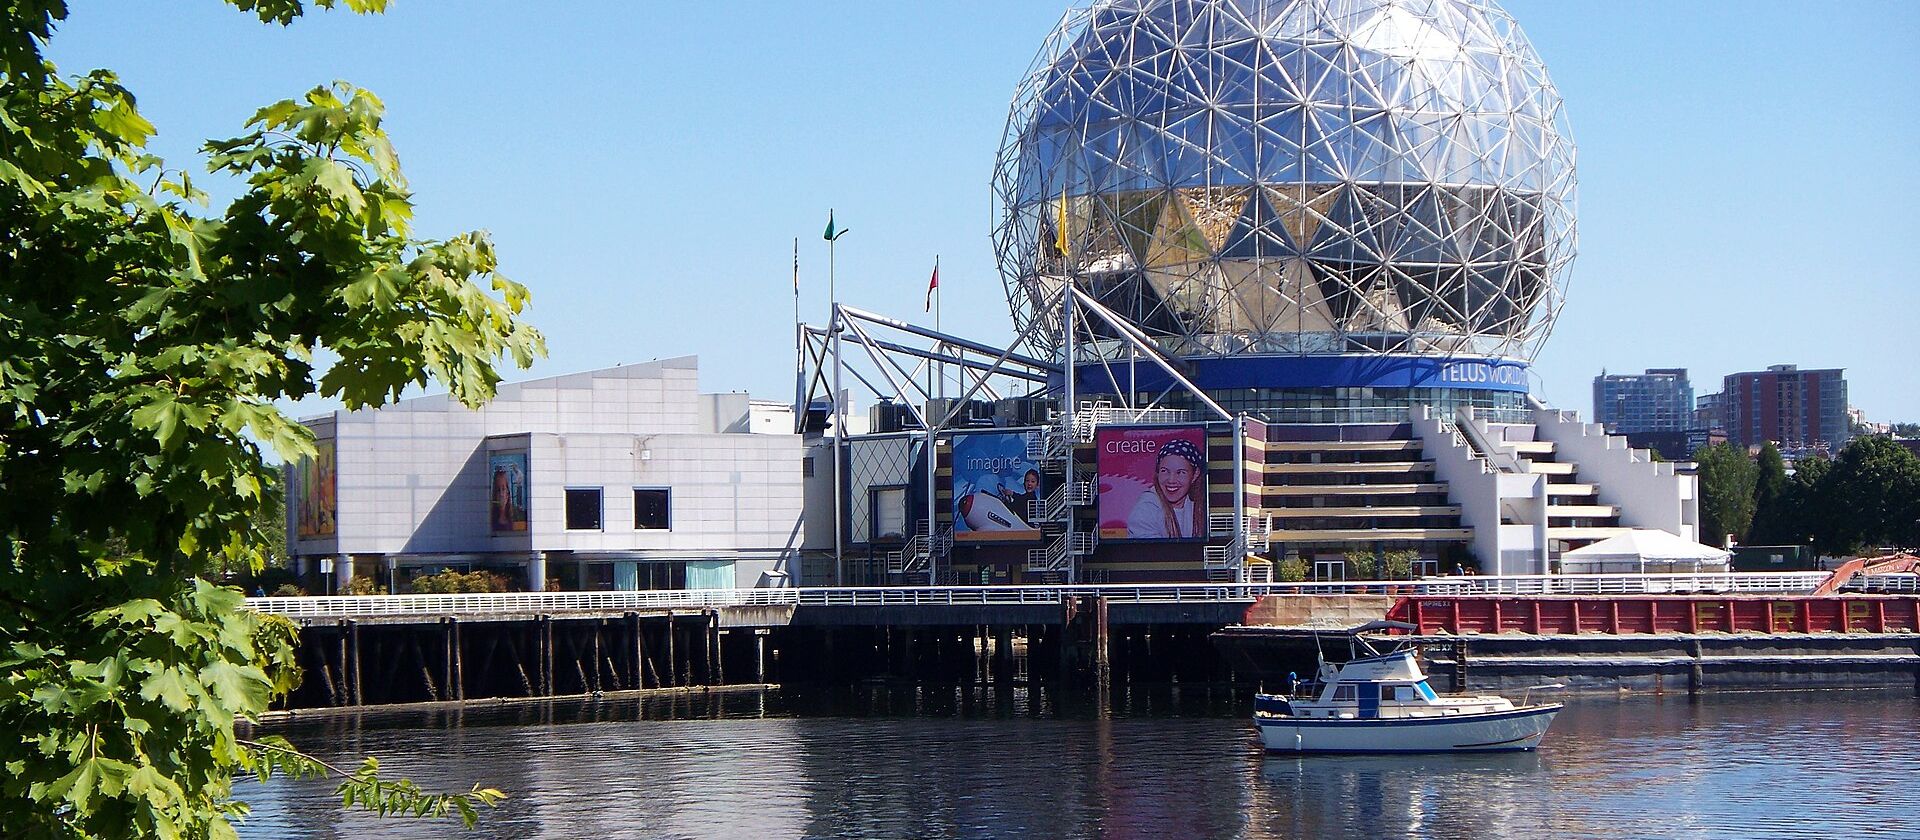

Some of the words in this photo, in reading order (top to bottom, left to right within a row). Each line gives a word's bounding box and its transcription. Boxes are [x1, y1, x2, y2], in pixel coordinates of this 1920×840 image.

[1442, 362, 1486, 382] TELUS
[1488, 365, 1522, 385] WORLD
[1106, 439, 1156, 453] create
[967, 454, 1021, 474] imagine
[1441, 643, 1453, 651] XX
